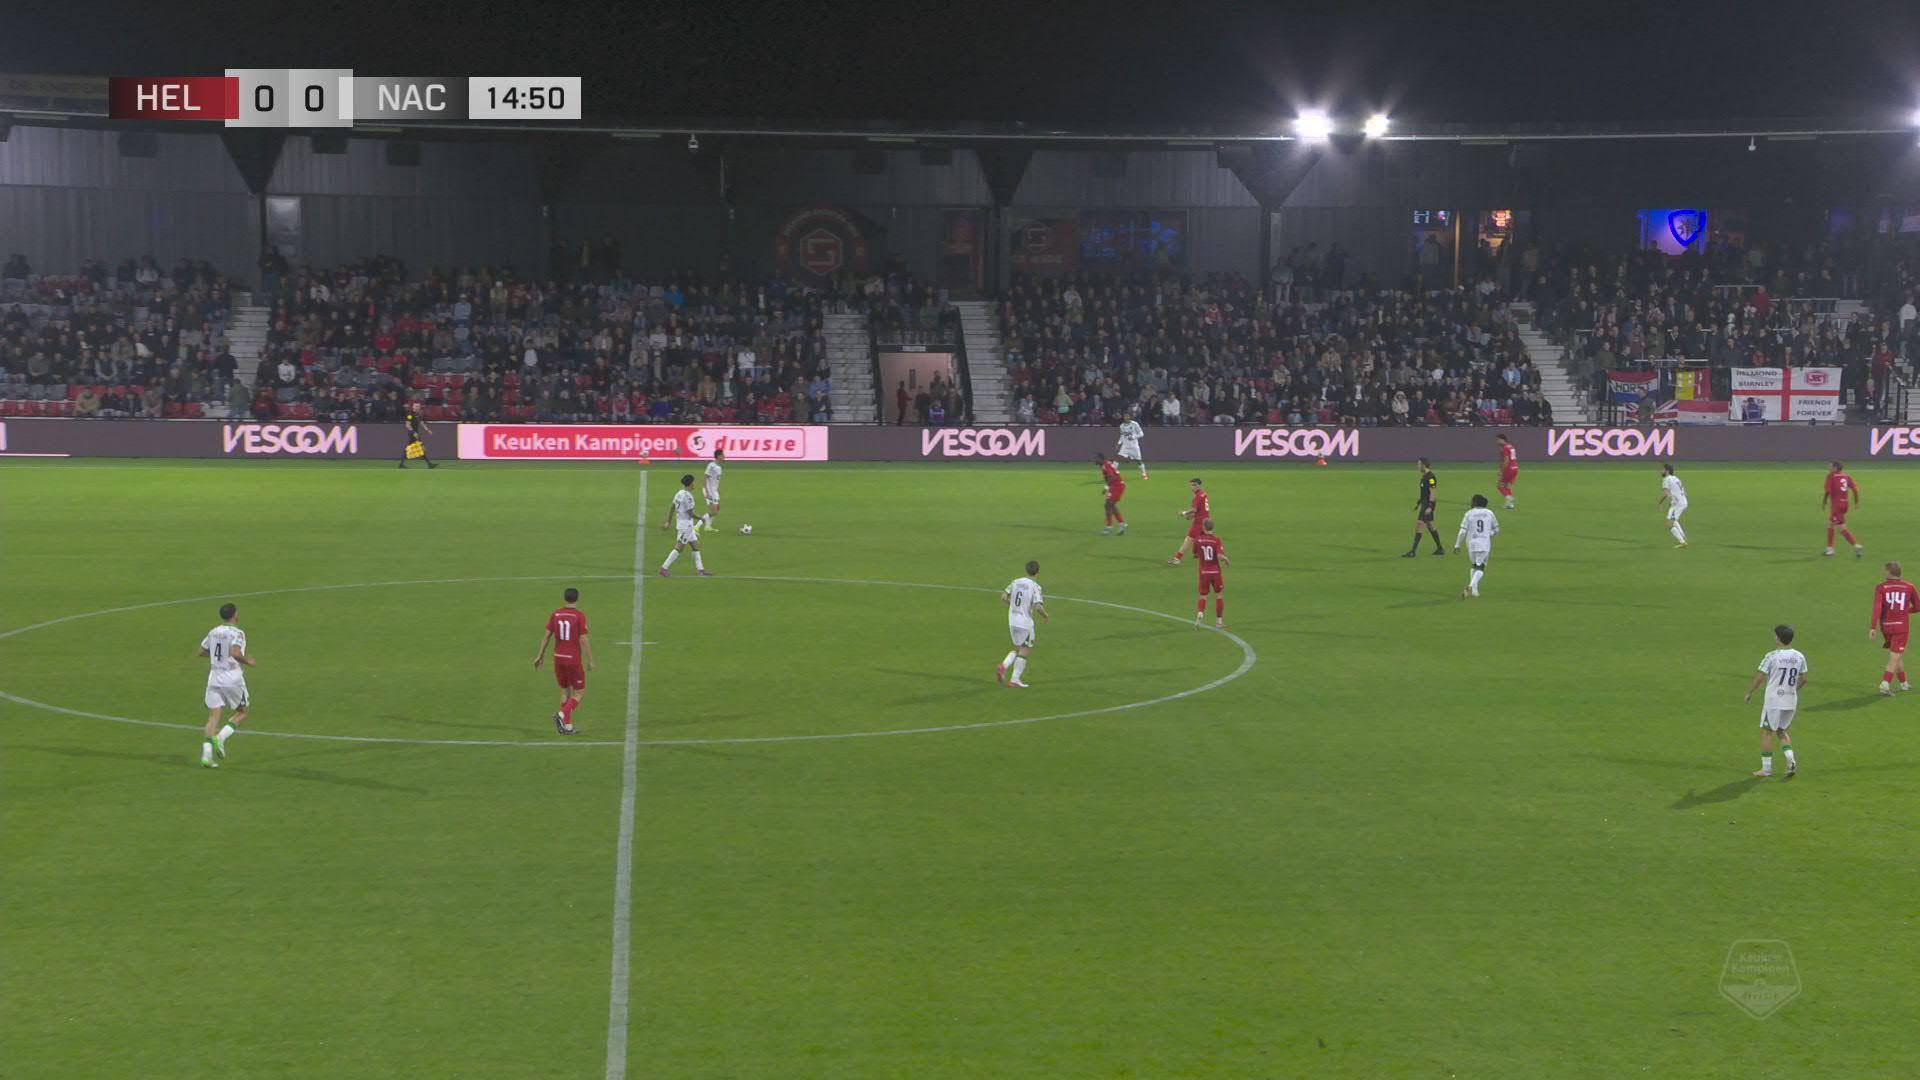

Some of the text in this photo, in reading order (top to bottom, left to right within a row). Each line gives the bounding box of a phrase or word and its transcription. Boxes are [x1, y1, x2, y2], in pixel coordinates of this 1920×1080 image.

[223, 424, 357, 454] VESCOM
[493, 433, 569, 450] Keuken
[575, 433, 678, 455] Kampioen
[922, 428, 1045, 456] VESCOM
[1235, 428, 1359, 456] VESCOM
[1547, 428, 1675, 456] VESCOM
[1840, 478, 1848, 492] 3
[1476, 519, 1484, 533] 9
[1201, 545, 1214, 560] 10
[1015, 591, 1023, 607] 6
[1885, 591, 1906, 611] 44
[558, 619, 571, 641] 11
[214, 643, 222, 661] 4
[1778, 667, 1798, 687] 78
